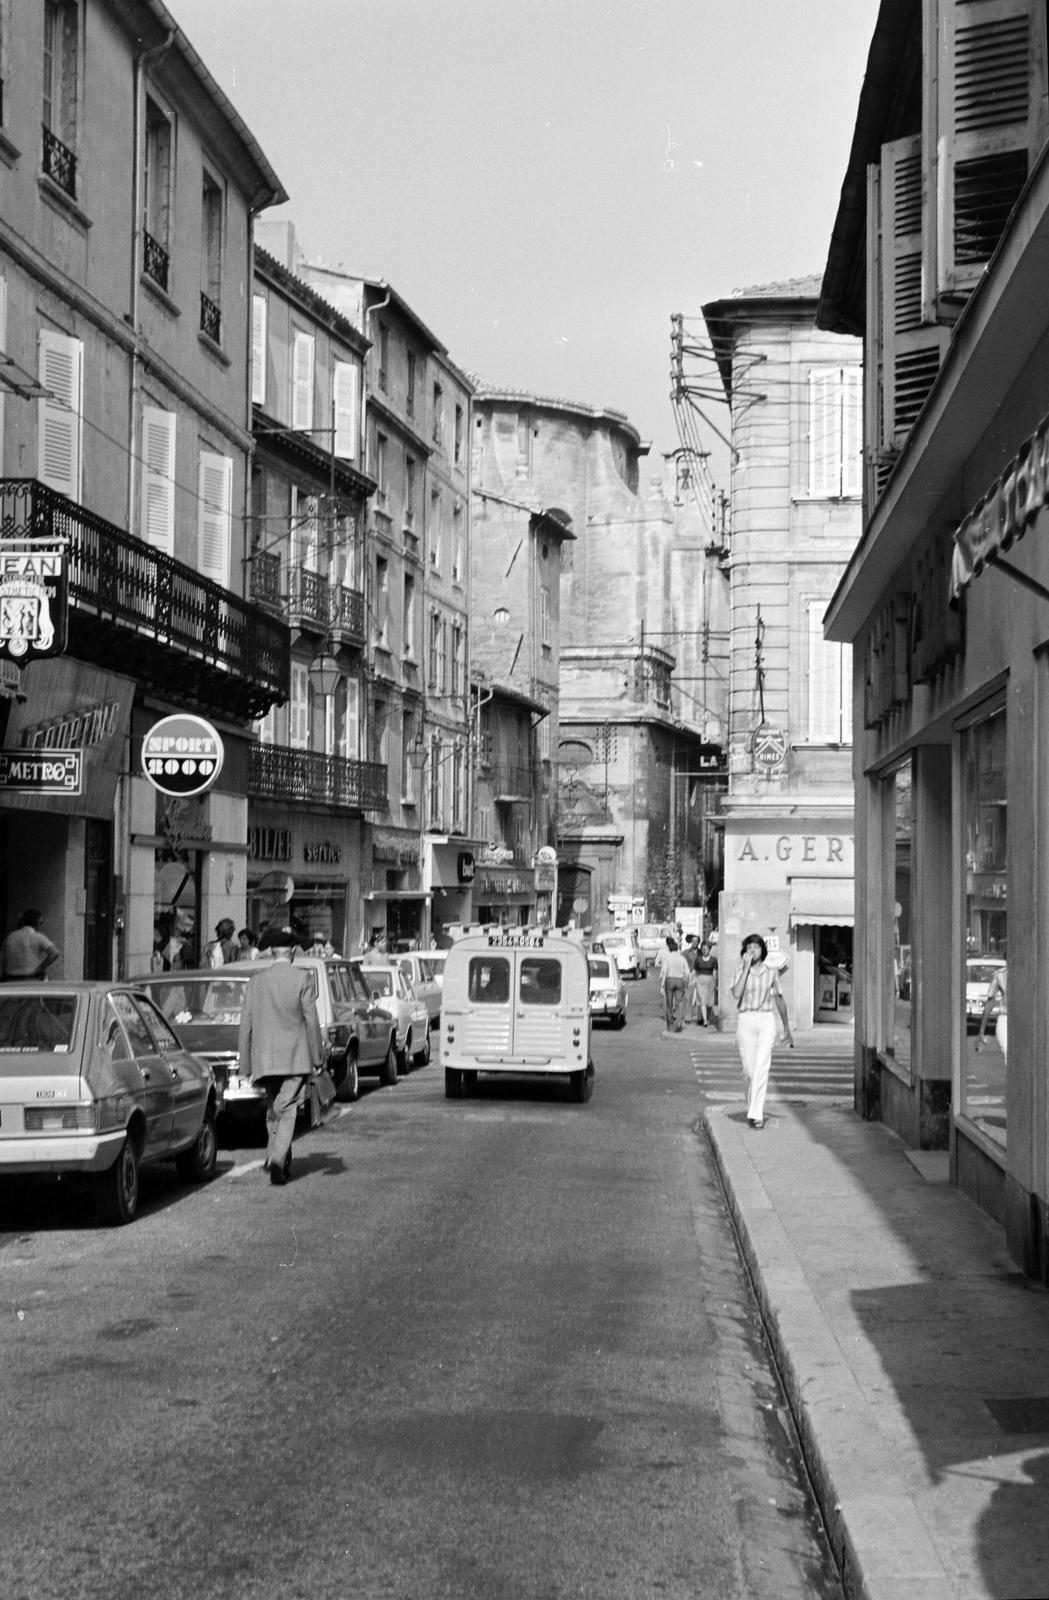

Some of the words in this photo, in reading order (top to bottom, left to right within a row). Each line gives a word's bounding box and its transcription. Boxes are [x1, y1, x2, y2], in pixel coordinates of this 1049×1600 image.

[0, 558, 56, 576] EAN
[148, 736, 215, 753] SPORT
[8, 762, 66, 782] METRO
[148, 758, 214, 776] 2000
[249, 828, 293, 858] BILIER
[306, 842, 342, 863] service
